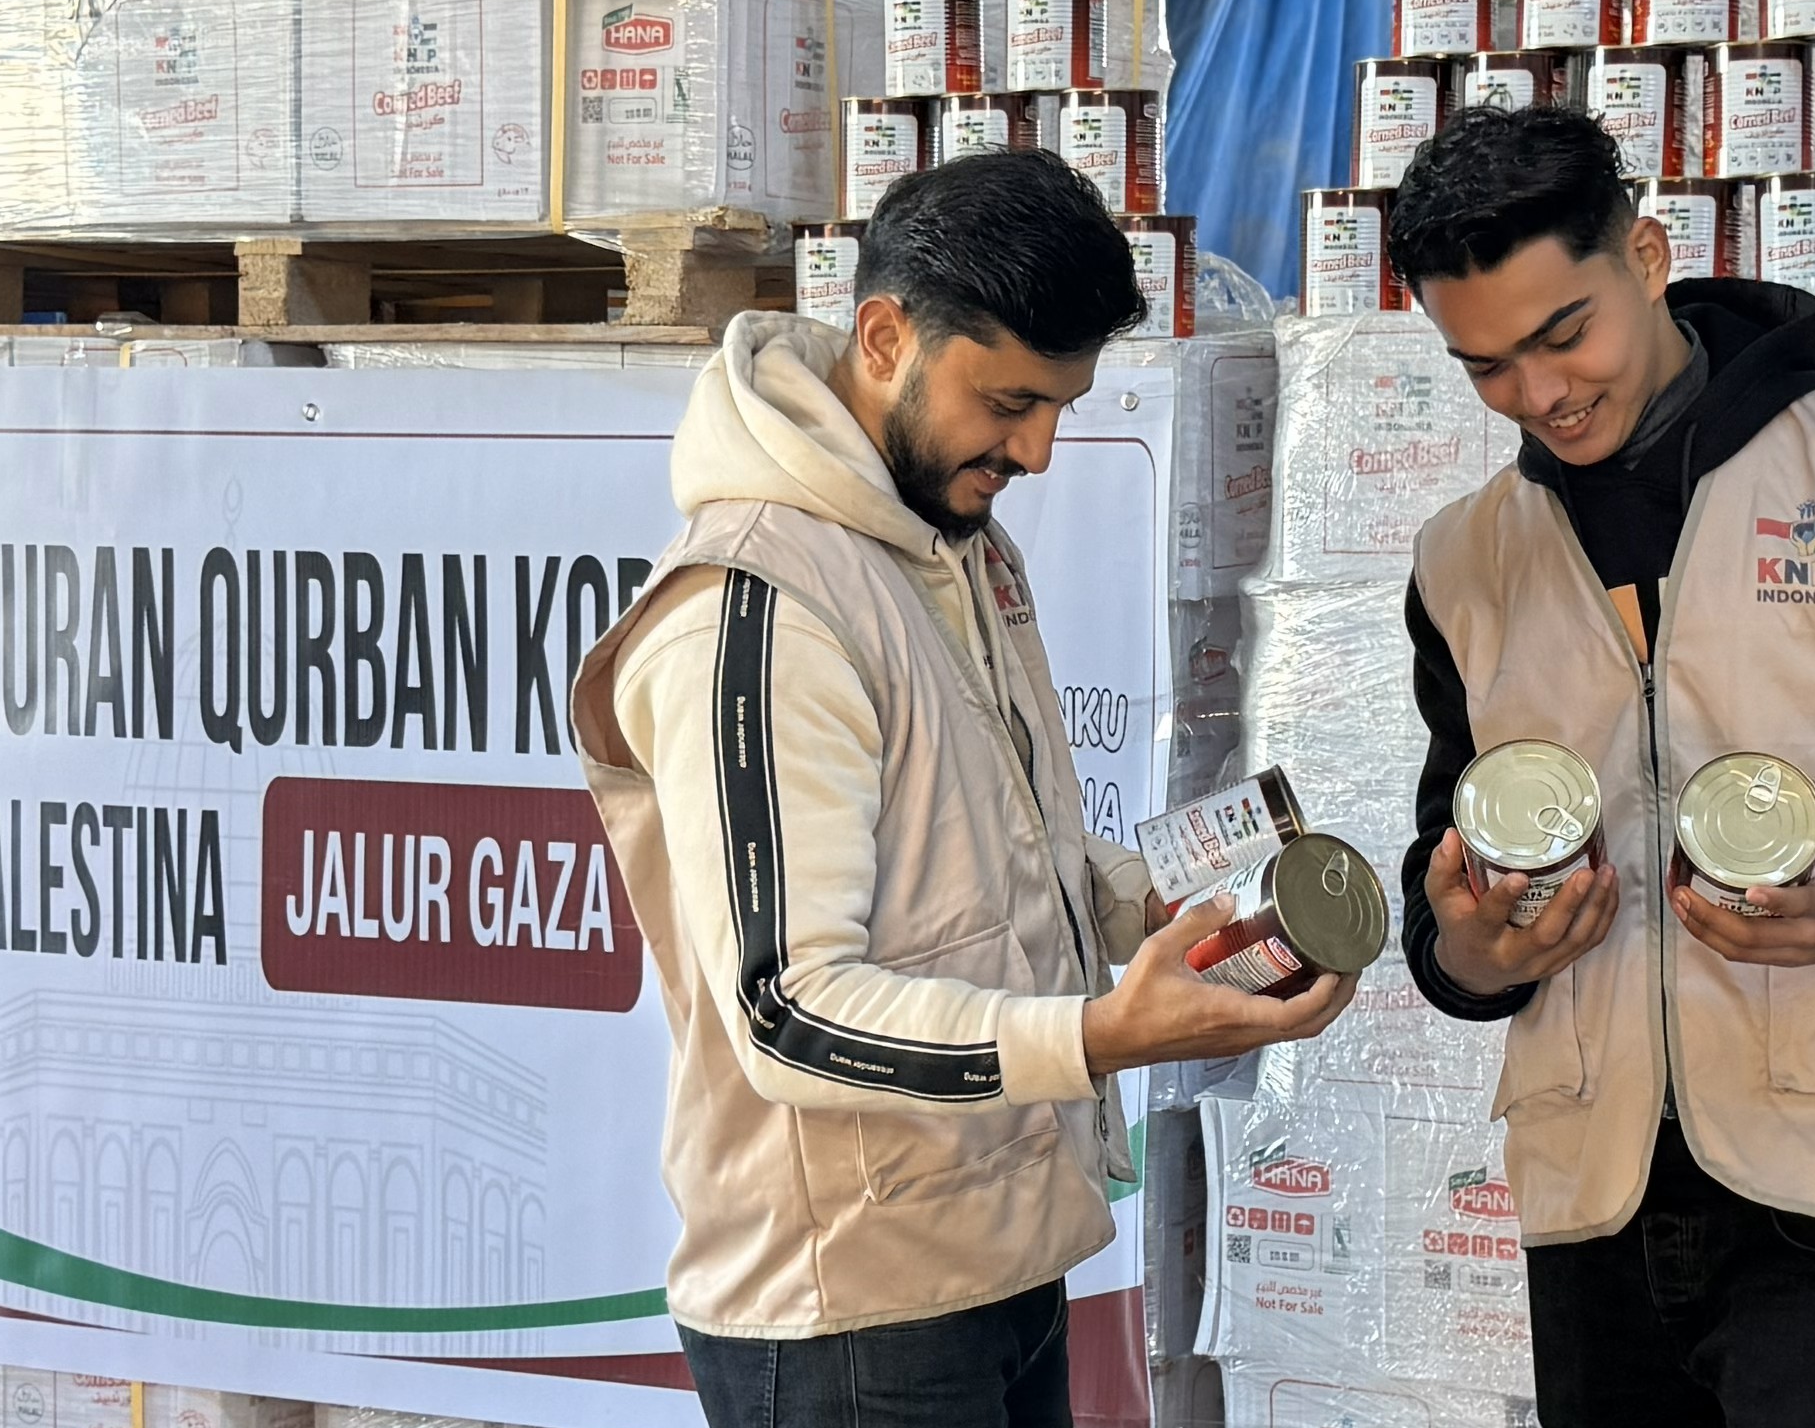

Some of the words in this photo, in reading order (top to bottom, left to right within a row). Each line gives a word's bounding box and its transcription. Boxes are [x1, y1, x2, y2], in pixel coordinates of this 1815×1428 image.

[610, 26, 664, 44] HANA
[421, 79, 461, 108] Beef
[1745, 87, 1781, 98] KNP
[1380, 102, 1413, 113] KNP
[607, 154, 624, 165] Not
[626, 154, 643, 165] For
[644, 154, 666, 165] Sale
[1324, 232, 1357, 242] KNP
[200, 545, 487, 754] QURBAN
[514, 555, 654, 756] KO
[286, 830, 451, 944] JALUR
[470, 836, 614, 955] GAZA
[1260, 1167, 1322, 1189] HANA
[1256, 1296, 1277, 1310] Not
[1279, 1298, 1297, 1311] For
[1300, 1300, 1324, 1315] Sale
